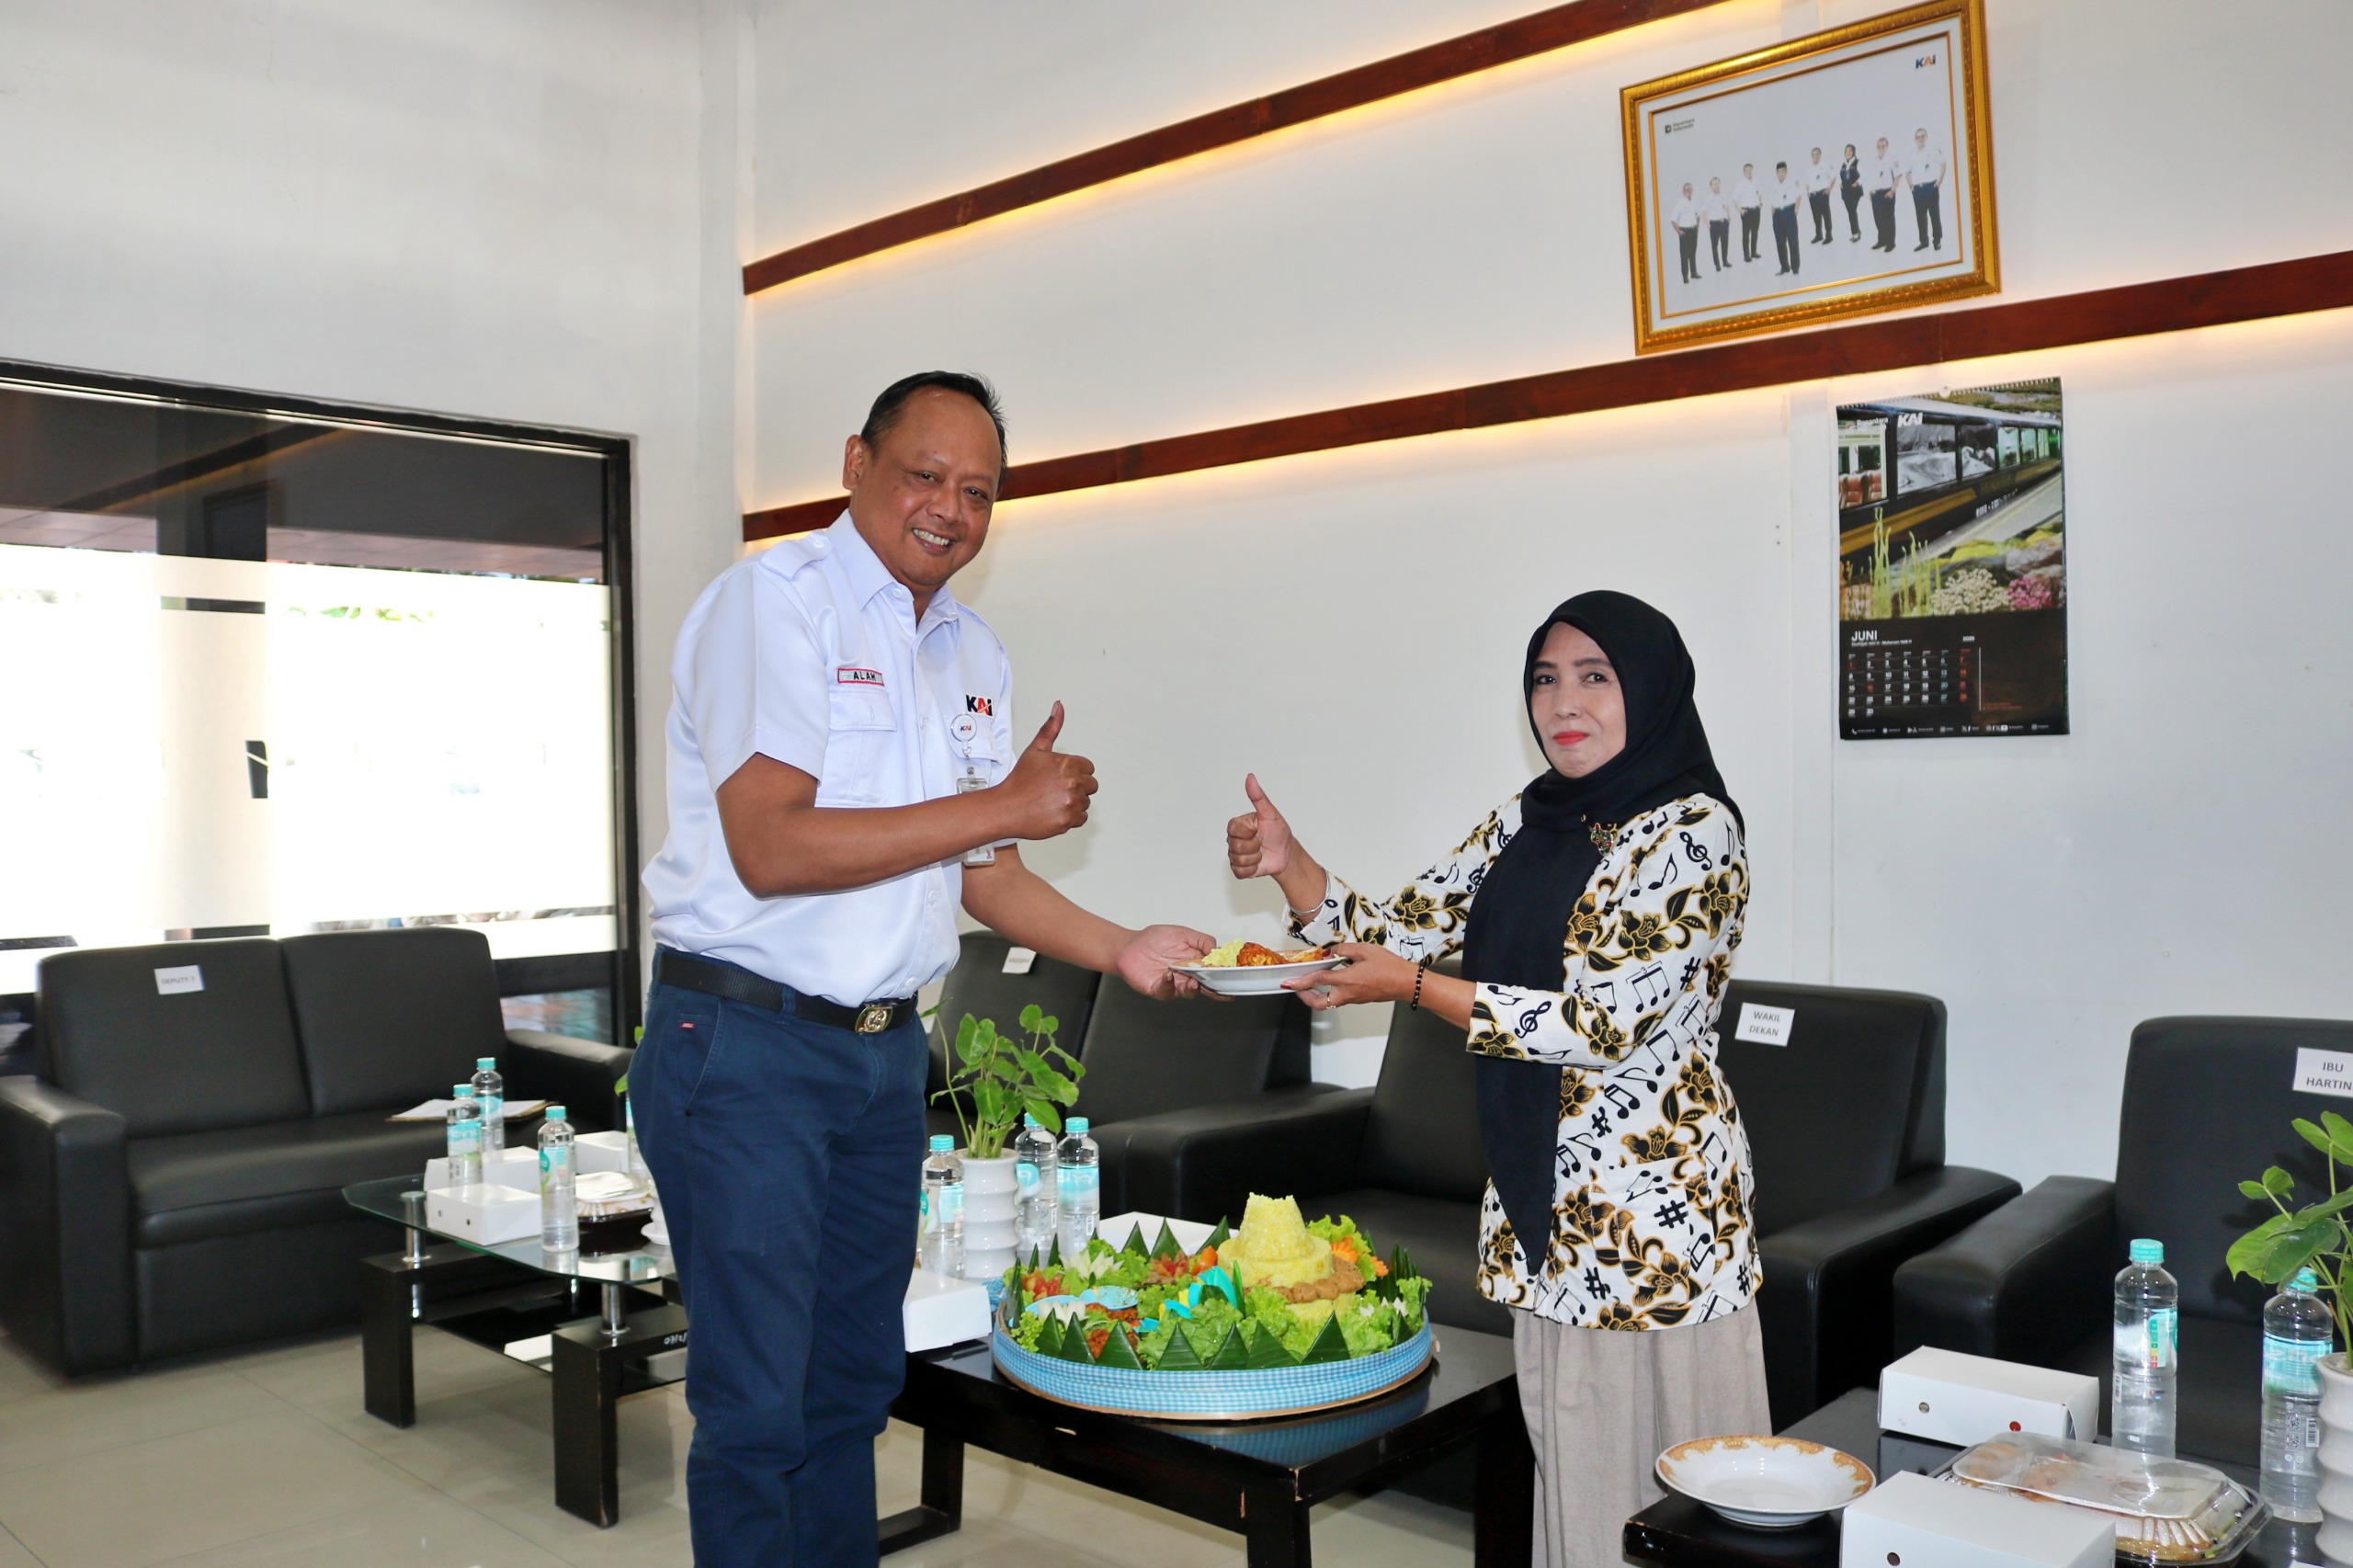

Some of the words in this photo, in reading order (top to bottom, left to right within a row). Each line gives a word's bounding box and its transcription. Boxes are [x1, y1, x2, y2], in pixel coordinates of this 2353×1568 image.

[1898, 412, 1923, 426] KAI
[1851, 630, 1878, 642] JUNI
[966, 694, 993, 717] KAI
[1754, 1011, 1781, 1022] WAKIL
[1749, 1025, 1779, 1036] DEKAN
[2323, 1062, 2344, 1073] IBU
[2306, 1077, 2353, 1091] HARTIN
